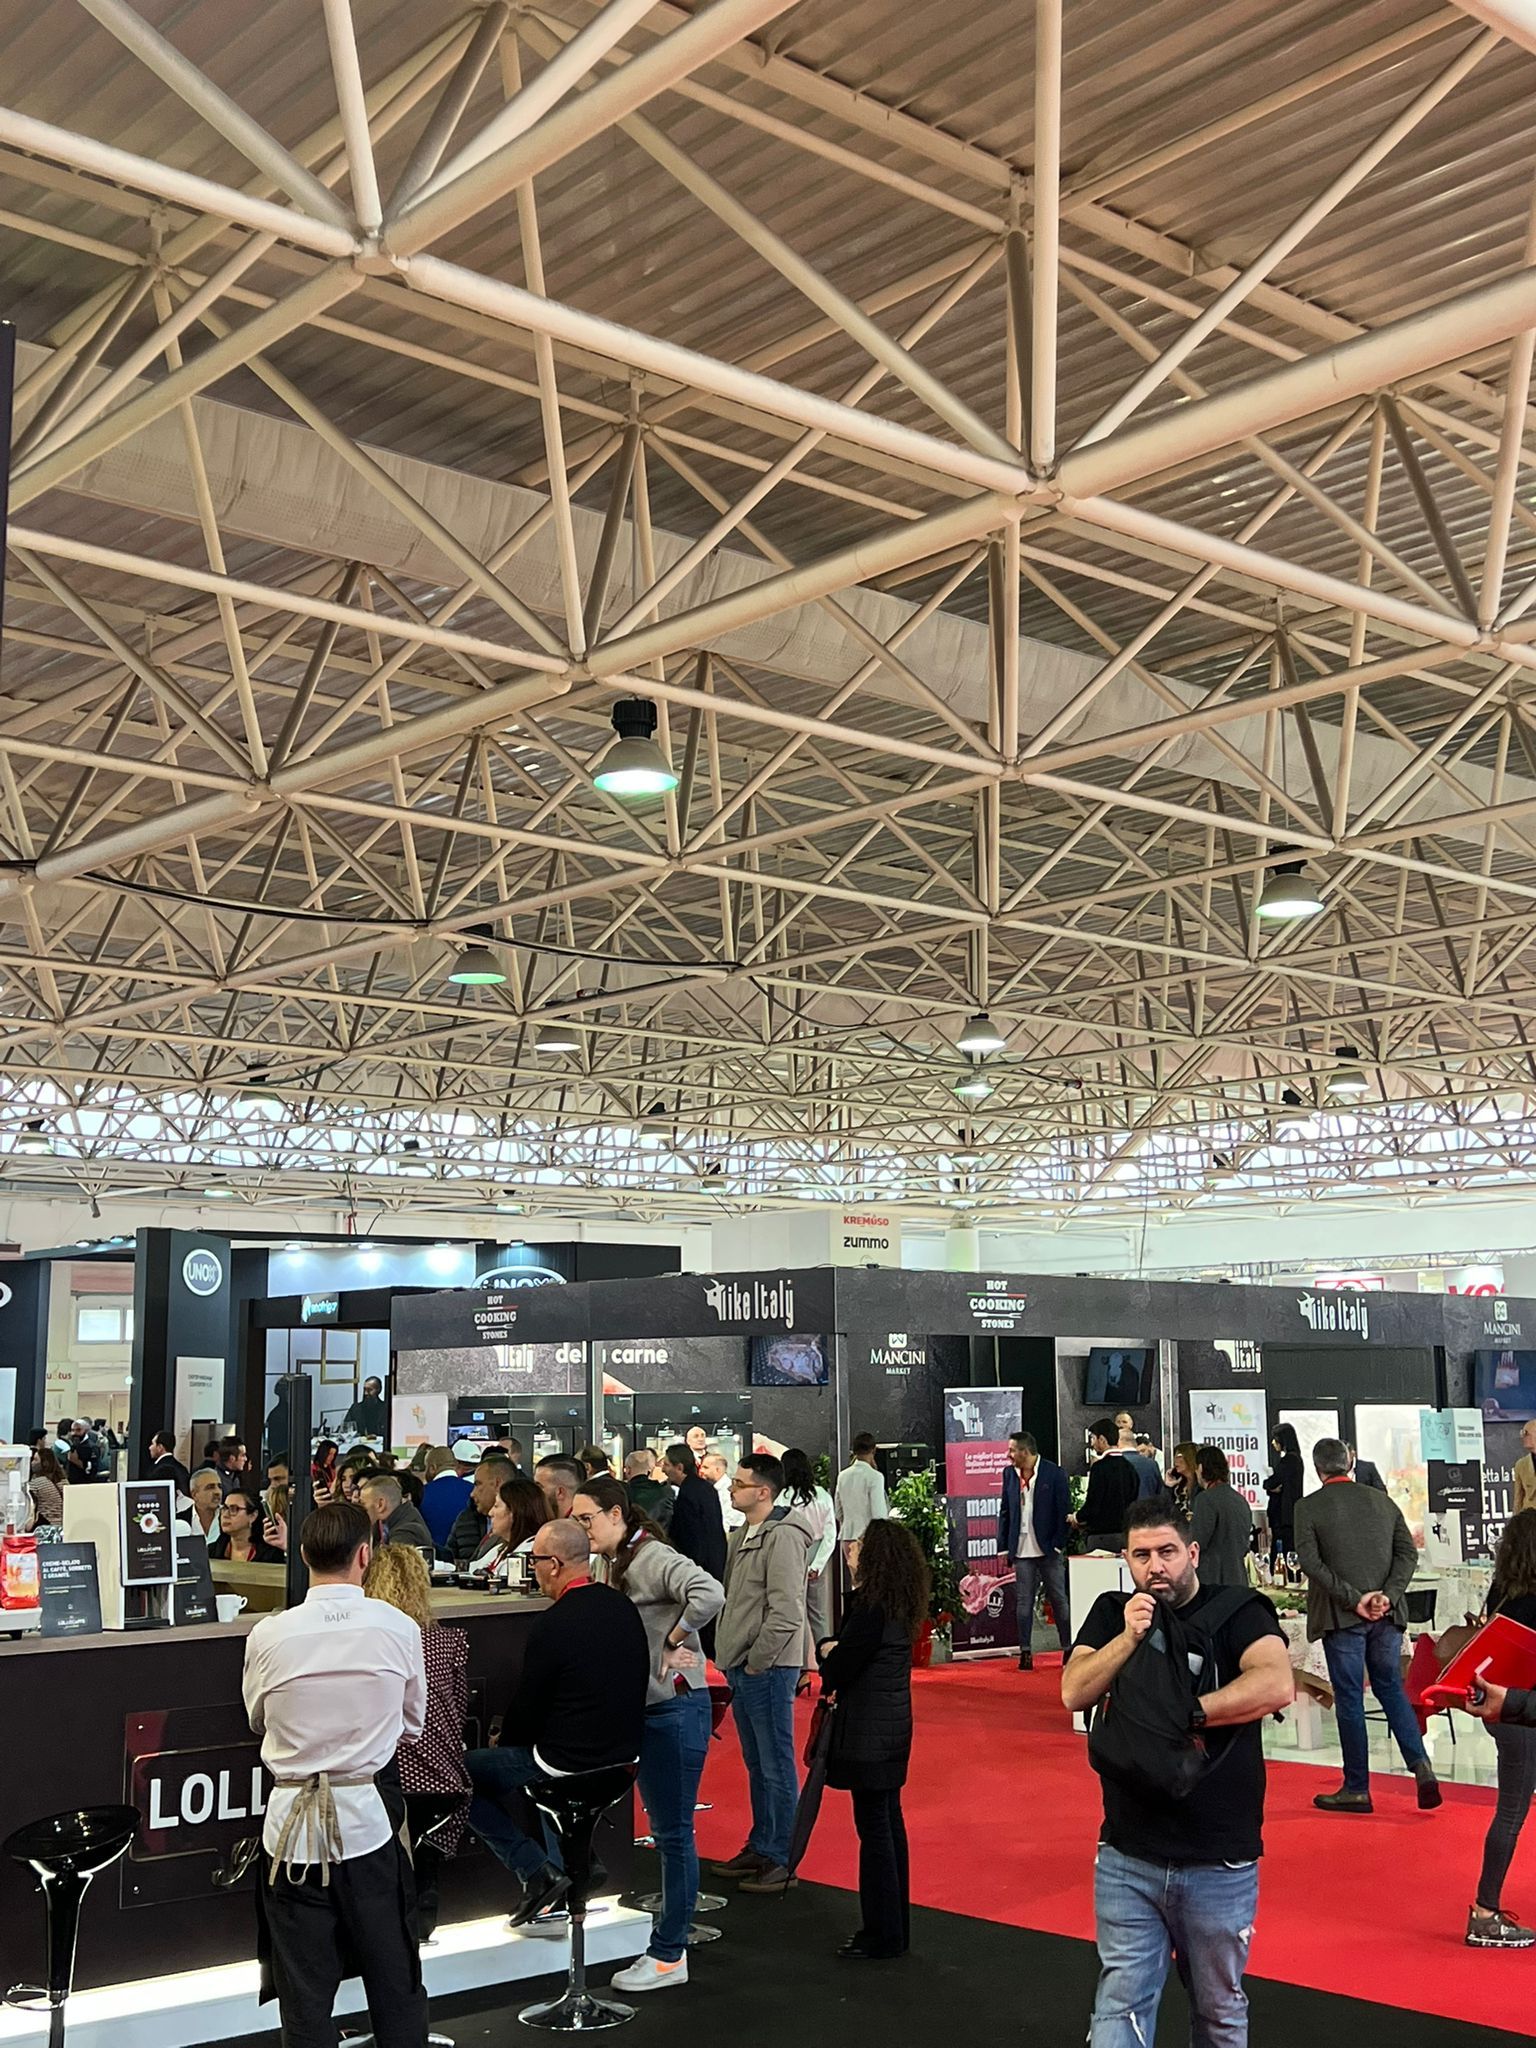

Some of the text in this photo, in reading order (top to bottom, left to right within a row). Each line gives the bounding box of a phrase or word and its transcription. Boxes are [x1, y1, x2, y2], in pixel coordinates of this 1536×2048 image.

[843, 1236, 889, 1249] zummo
[986, 1281, 1007, 1291] HOT
[487, 1296, 503, 1305] HOT
[754, 1279, 794, 1329] Italy
[970, 1298, 1025, 1311] COOKING
[474, 1312, 517, 1324] COOKING
[981, 1319, 1015, 1329] STONES
[1338, 1297, 1368, 1340] Italy
[482, 1331, 508, 1339] STONES
[1483, 1321, 1521, 1336] MANCINI
[611, 1349, 669, 1364] carne
[870, 1349, 926, 1365] MANCINI
[886, 1367, 911, 1375] MARKET
[1501, 1466, 1510, 1481] la
